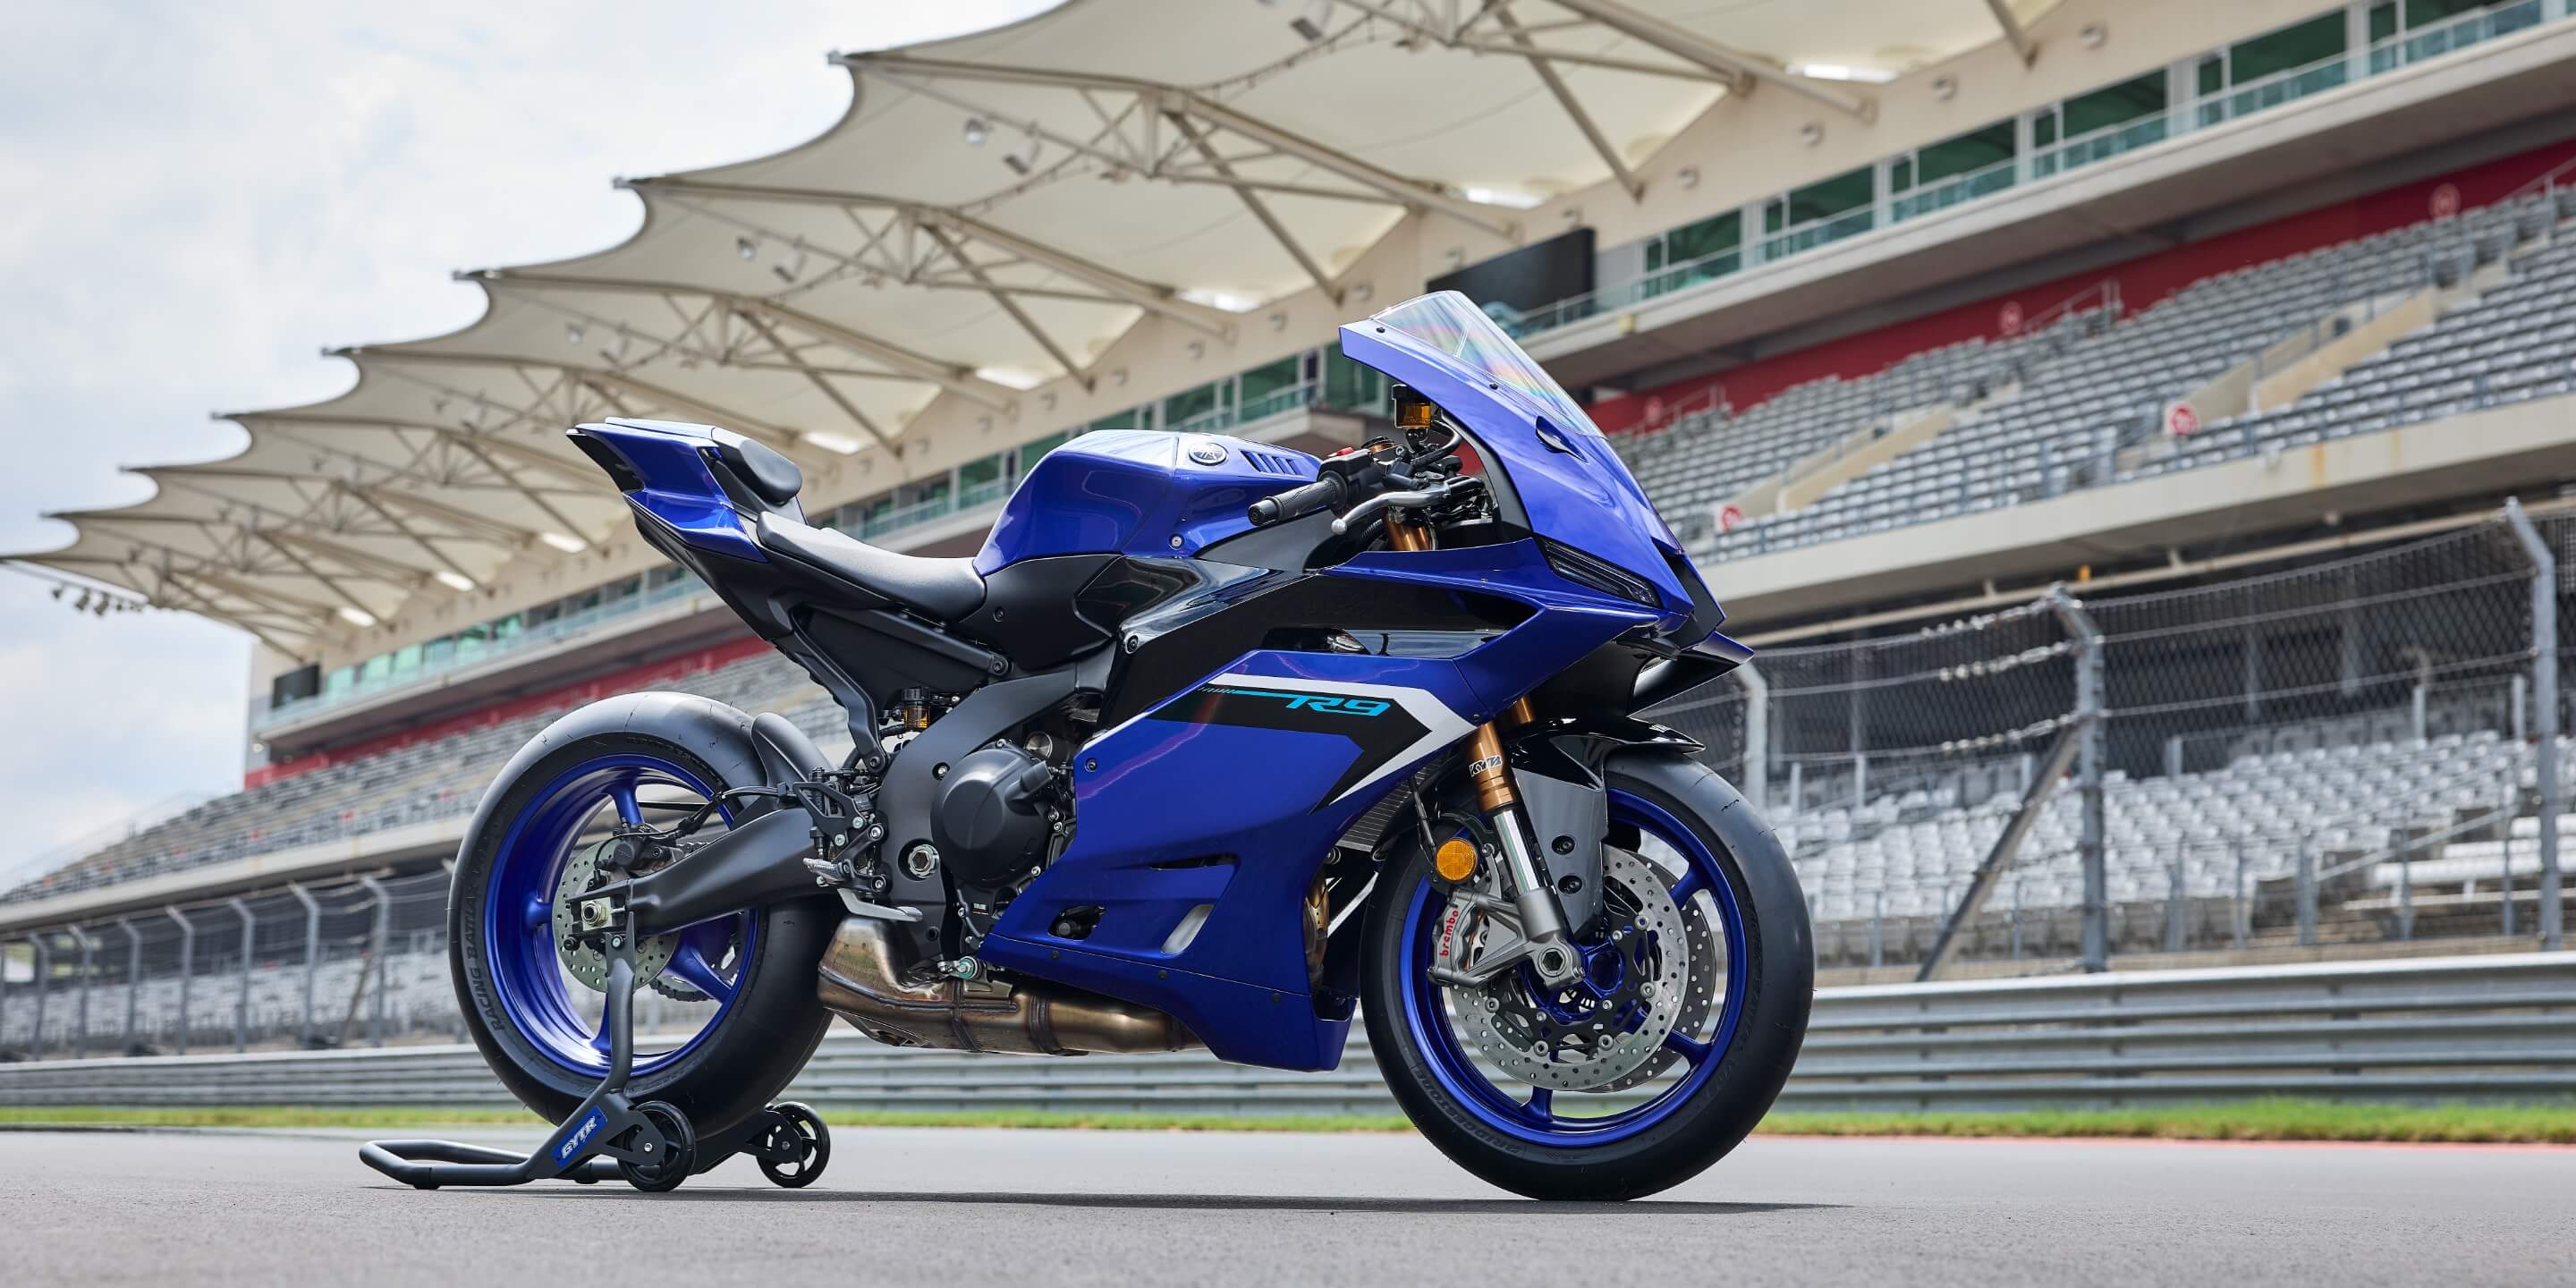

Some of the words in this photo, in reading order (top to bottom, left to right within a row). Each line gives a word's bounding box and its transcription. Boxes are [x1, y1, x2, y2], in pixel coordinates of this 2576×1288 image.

[1285, 698, 1391, 716] R9
[1469, 755, 1503, 777] KYB
[1440, 911, 1459, 956] brembo
[470, 967, 505, 1030] RACING
[562, 1115, 597, 1158] GYTR
